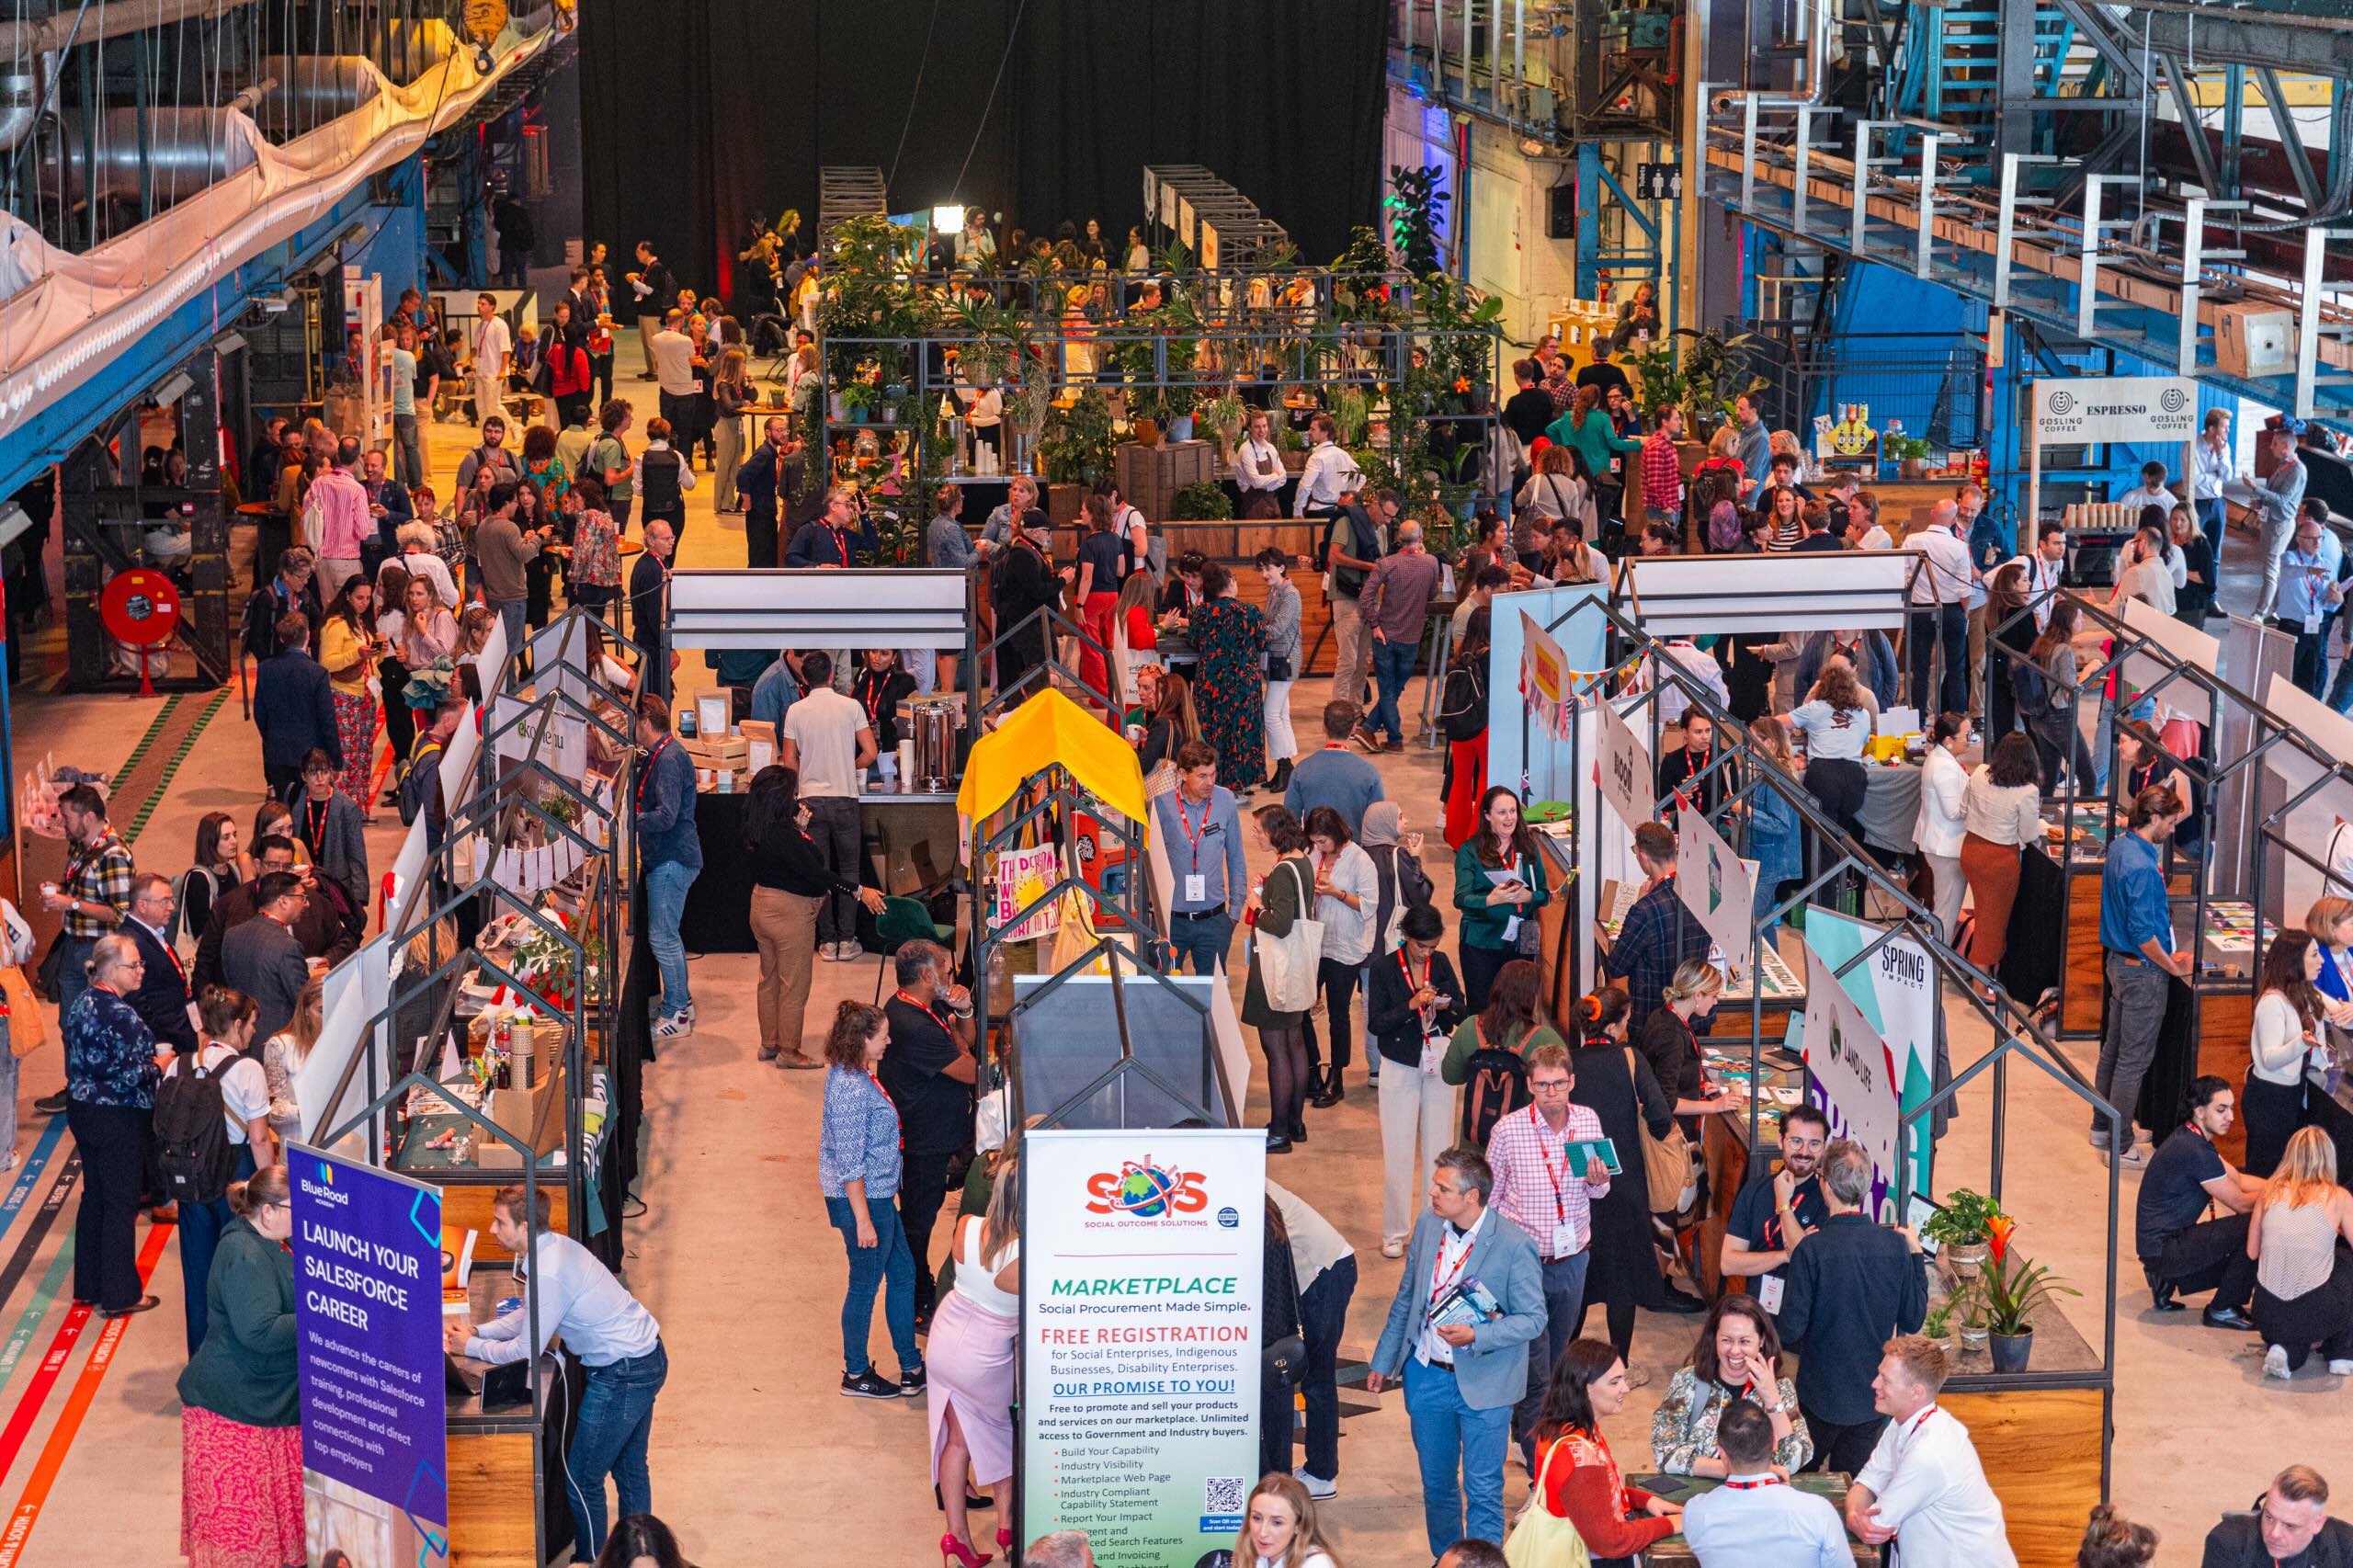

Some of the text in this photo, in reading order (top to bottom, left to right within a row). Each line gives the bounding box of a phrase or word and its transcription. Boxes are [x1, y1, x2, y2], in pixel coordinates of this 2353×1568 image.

[2086, 404, 2147, 415] ESPRESSO
[2039, 417, 2083, 426] GOSLING
[1001, 859, 1015, 881] TH
[1882, 944, 1925, 983] SPRING
[1881, 971, 1924, 990] IMPACT
[1844, 1036, 1871, 1094] LAND LIFE
[49, 1185, 70, 1204] THEATRE
[315, 1199, 335, 1209] ACADEMY
[303, 1220, 419, 1279] LAUNCH YOUR
[305, 1256, 408, 1311] SALESFORCE
[1051, 1277, 1237, 1296] MARKETPLACE
[307, 1290, 369, 1331] CAREER
[1039, 1301, 1251, 1314] Social Procurement Made Simple.
[1041, 1326, 1248, 1344] FREE REGISTRATION
[48, 1349, 67, 1364] HALL
[309, 1330, 422, 1384] We advance the careers of
[1051, 1347, 1237, 1360] for Social Enterprises, Indigenous
[1051, 1362, 1237, 1376] Businesses, Disability Enterprises.
[310, 1355, 426, 1407] newcomers with Salesforce
[1053, 1379, 1235, 1395] OUR PROMISE TO YOU!
[311, 1375, 397, 1418] training, professional
[1050, 1401, 1238, 1414] Free to promote and sell your products
[312, 1397, 411, 1446] development and direct
[1038, 1417, 1056, 1426] and
[1059, 1417, 1097, 1426] services
[1135, 1415, 1198, 1426] marketplace.
[1201, 1414, 1249, 1423] Unlimited
[313, 1419, 384, 1456] connections with
[1039, 1427, 1248, 1440] access to Government and Industry buyers.
[313, 1439, 373, 1473] top employers
[1062, 1446, 1159, 1457] Build Your Capability
[1062, 1460, 1144, 1471] Industry Visibility
[1062, 1473, 1171, 1485] Marketplace Web Page
[1062, 1487, 1151, 1500] Industry Compliant
[1061, 1499, 1158, 1511] Capability Statement
[1061, 1513, 1153, 1525] Report Your Impact
[6, 1517, 31, 1542] SOUTH
[1109, 1527, 1128, 1536] and
[1108, 1538, 1140, 1547] Search
[1143, 1537, 1183, 1546] Features
[1097, 1551, 1160, 1562] and Invoicing
